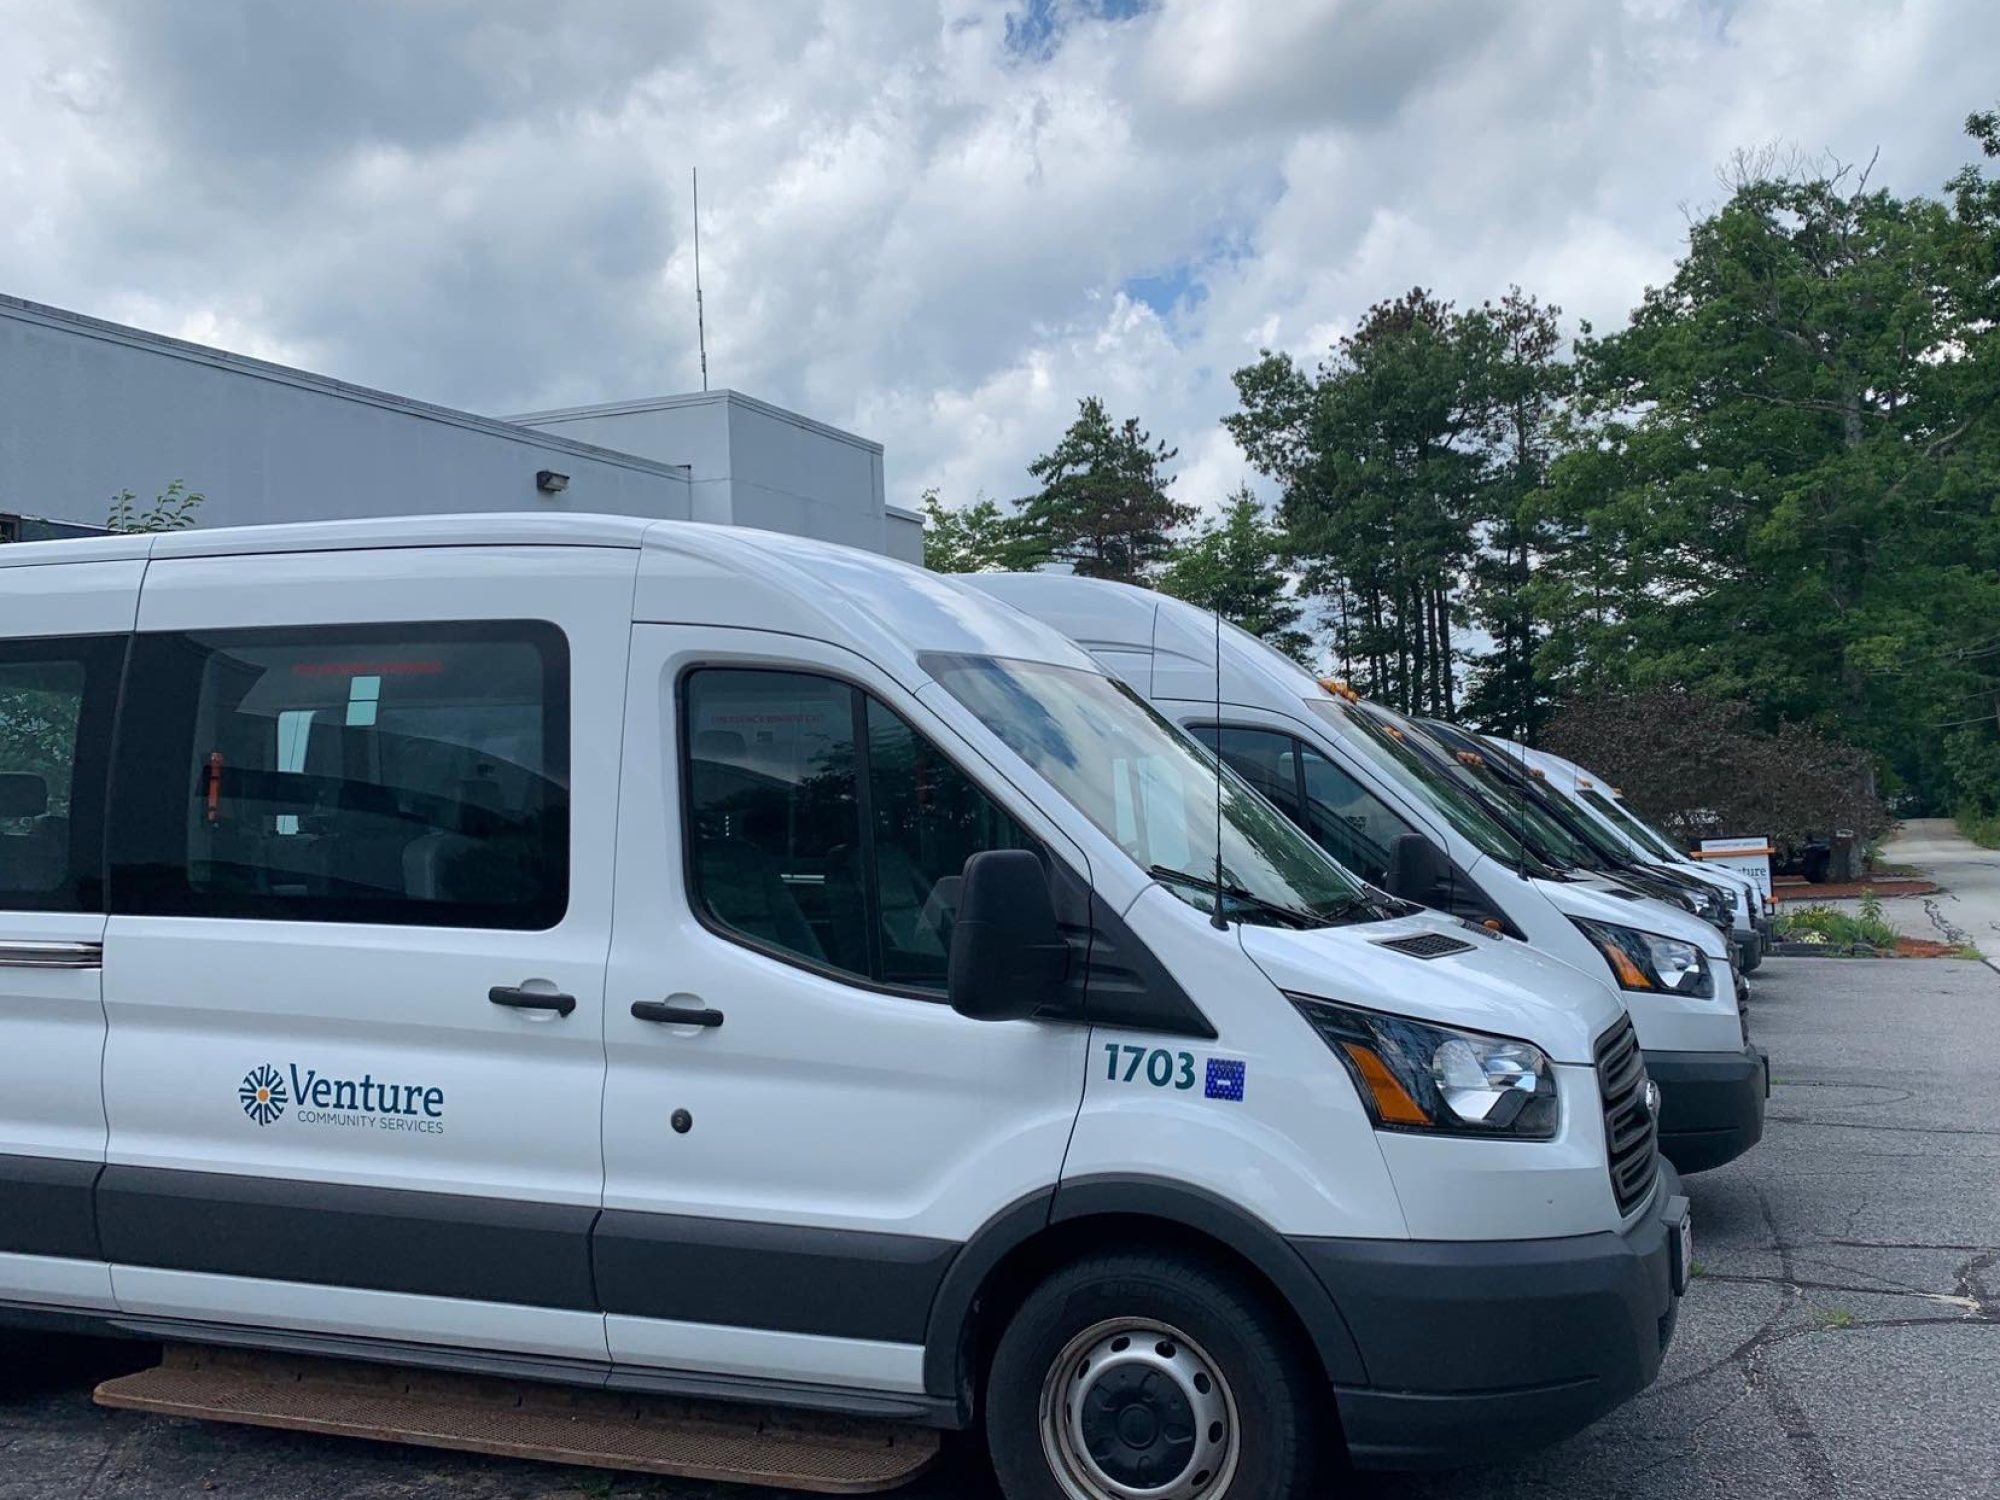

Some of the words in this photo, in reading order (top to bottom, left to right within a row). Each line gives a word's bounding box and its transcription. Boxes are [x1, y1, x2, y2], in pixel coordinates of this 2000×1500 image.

[289, 1063, 444, 1117] Venture
[1105, 1043, 1196, 1090] 1703
[297, 1110, 377, 1128] COMMUNITY
[380, 1117, 444, 1134] SERVICES
